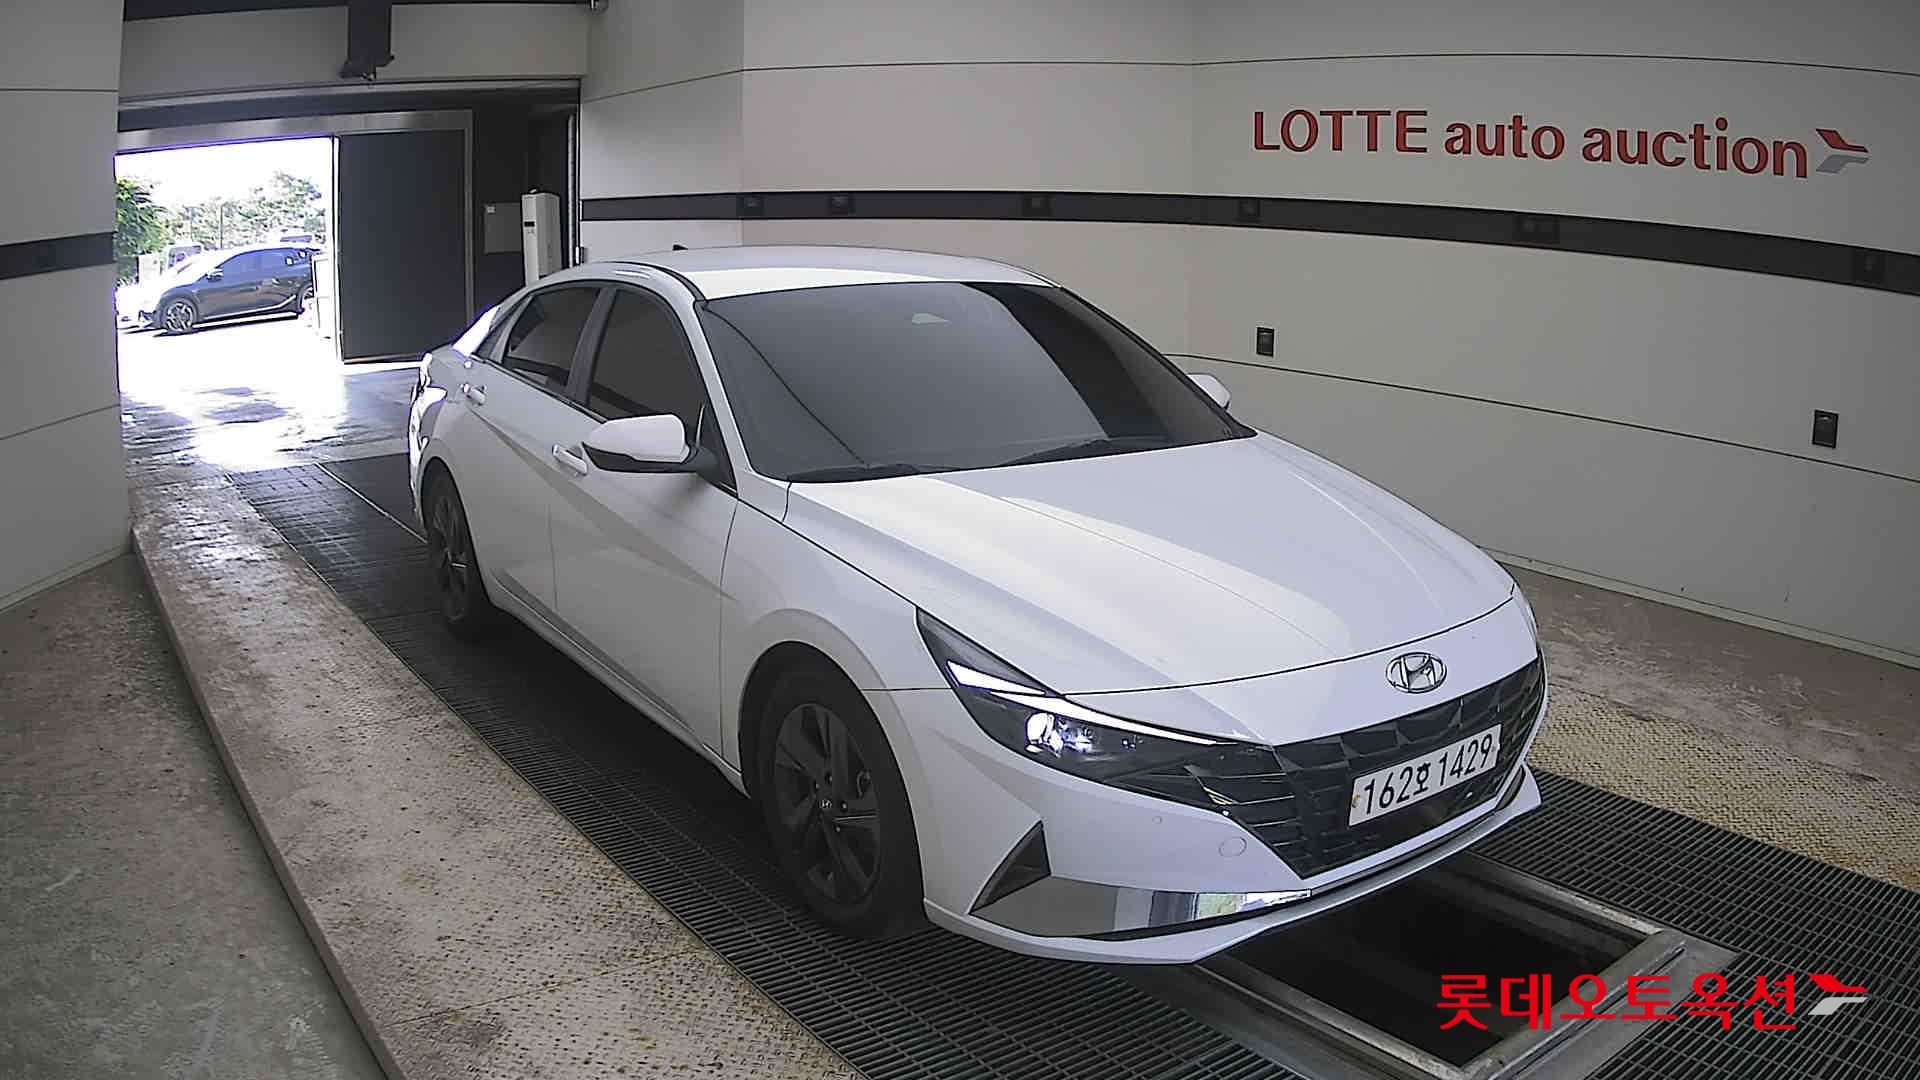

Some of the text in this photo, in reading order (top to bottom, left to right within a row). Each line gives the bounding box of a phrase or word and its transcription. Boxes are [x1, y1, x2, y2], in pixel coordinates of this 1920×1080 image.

[1252, 109, 1809, 179] LOTTE auto auction
[1363, 733, 1493, 815] 162호 1429
